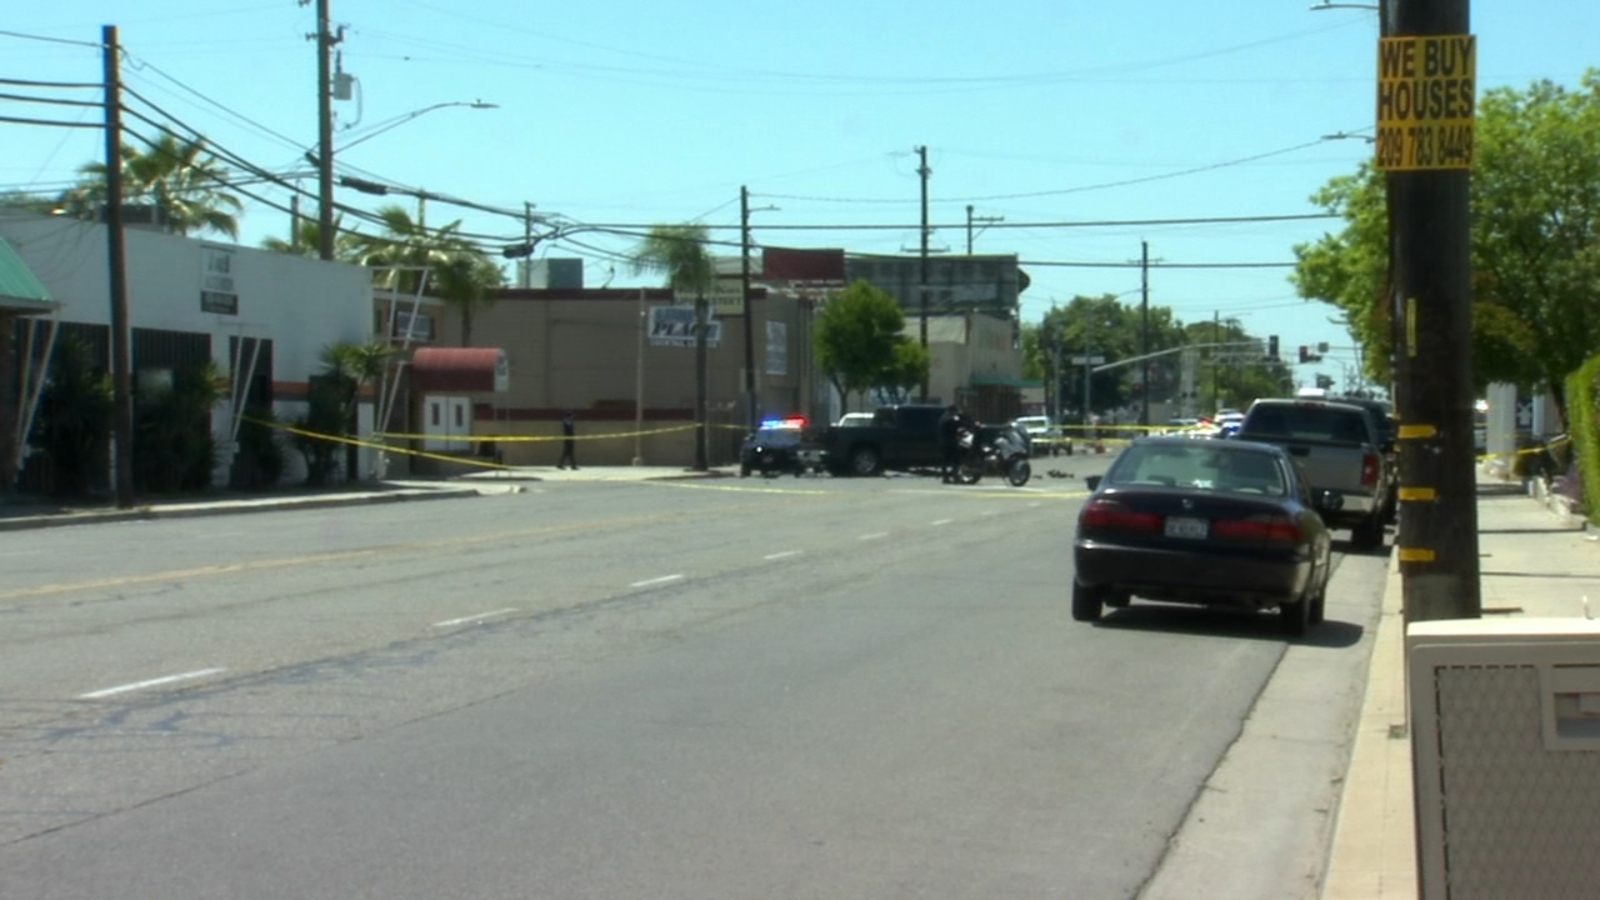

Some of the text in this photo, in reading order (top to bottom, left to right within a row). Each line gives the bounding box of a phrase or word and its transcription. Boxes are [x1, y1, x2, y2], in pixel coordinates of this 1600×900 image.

[1381, 38, 1471, 78] WE BUY
[1379, 79, 1473, 120] HOUSES
[1377, 125, 1473, 166] 209 783 8449
